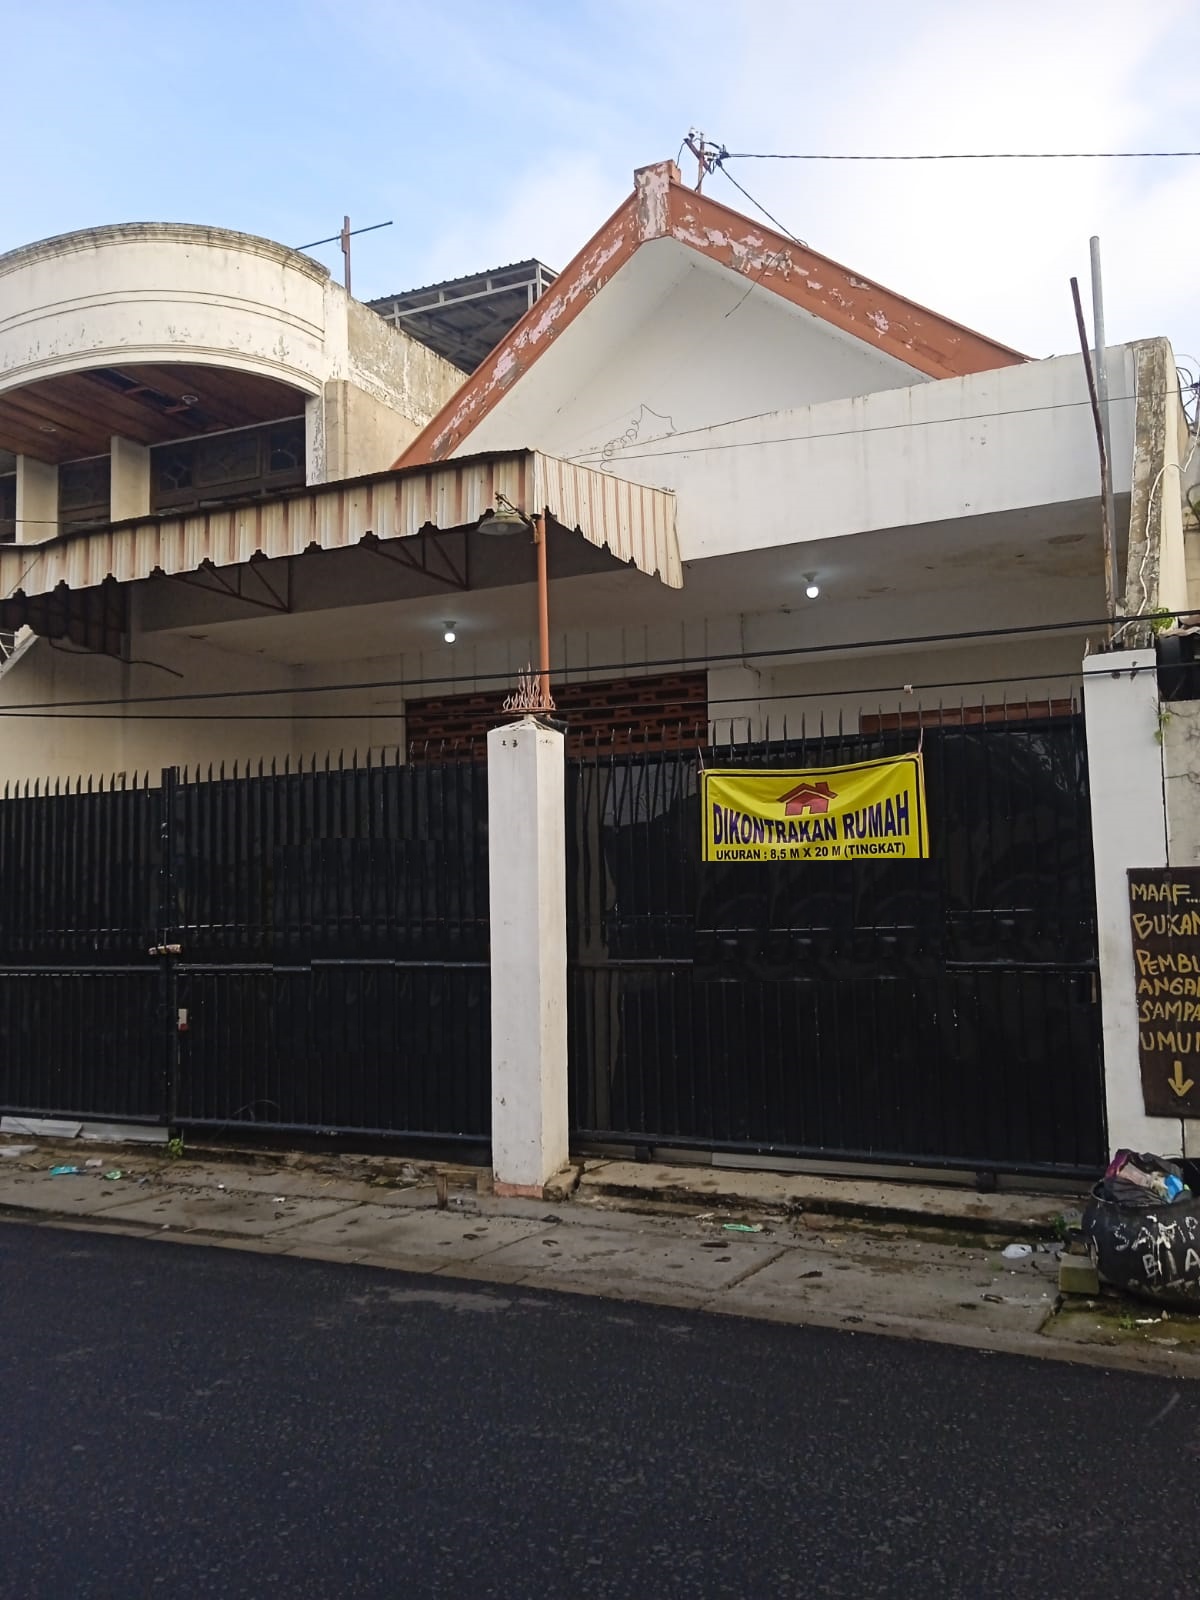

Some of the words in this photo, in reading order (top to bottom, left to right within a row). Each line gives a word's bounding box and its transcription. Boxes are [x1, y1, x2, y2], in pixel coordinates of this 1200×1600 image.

[713, 803, 837, 844] DIKONTRAKAN
[843, 790, 909, 839] RUMAH
[716, 849, 761, 860] UKURAN
[770, 848, 787, 860] 8,5
[790, 848, 799, 858] M
[803, 847, 812, 858] X
[815, 847, 828, 857] 20
[832, 846, 841, 856] M
[844, 842, 906, 858] (TINGKAT)
[1138, 976, 1200, 997] ANGA
